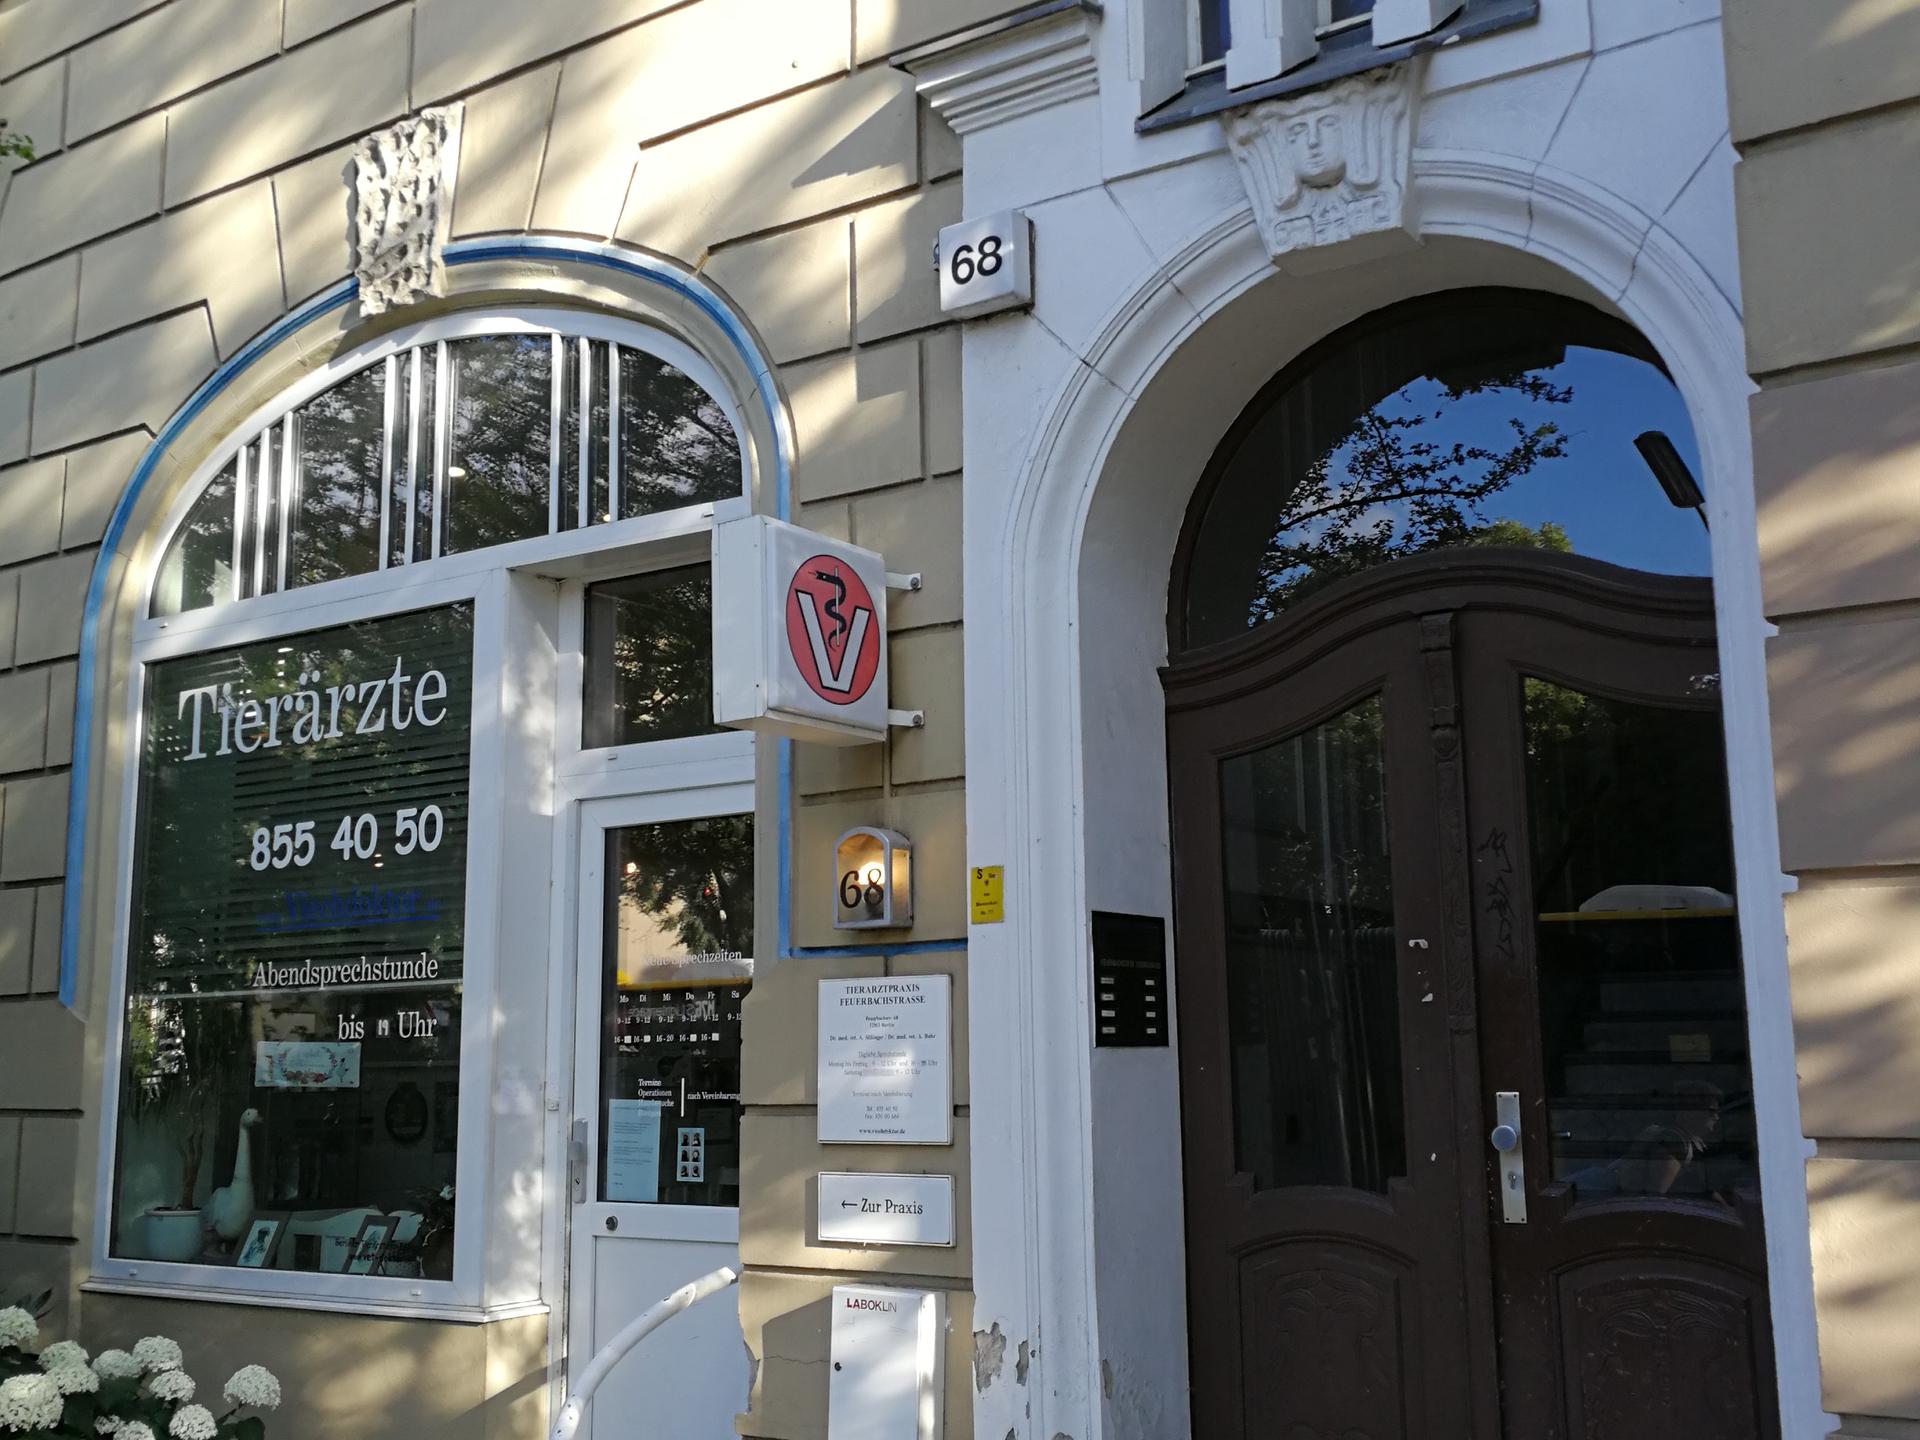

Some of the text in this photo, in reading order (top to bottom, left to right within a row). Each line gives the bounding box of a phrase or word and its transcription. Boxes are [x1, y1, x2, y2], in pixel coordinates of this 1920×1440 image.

[951, 235, 1003, 286] 68
[178, 656, 448, 762] Tierärzte
[249, 804, 444, 871] 855 40 50
[839, 867, 884, 909] 68
[671, 947, 742, 969] Sprechzeiten
[253, 951, 439, 991] Abendsprechstunde
[844, 983, 920, 996] TIERARZTPRAXIS
[839, 995, 926, 1007] FEUERBACHSTRASSE
[338, 1013, 364, 1040] bis
[396, 1010, 438, 1039] Uhr
[637, 1088, 672, 1098] Operationen
[687, 1092, 701, 1100] nach
[861, 1197, 924, 1215] Zur Praxis
[846, 1297, 897, 1313] LABOKLIN
